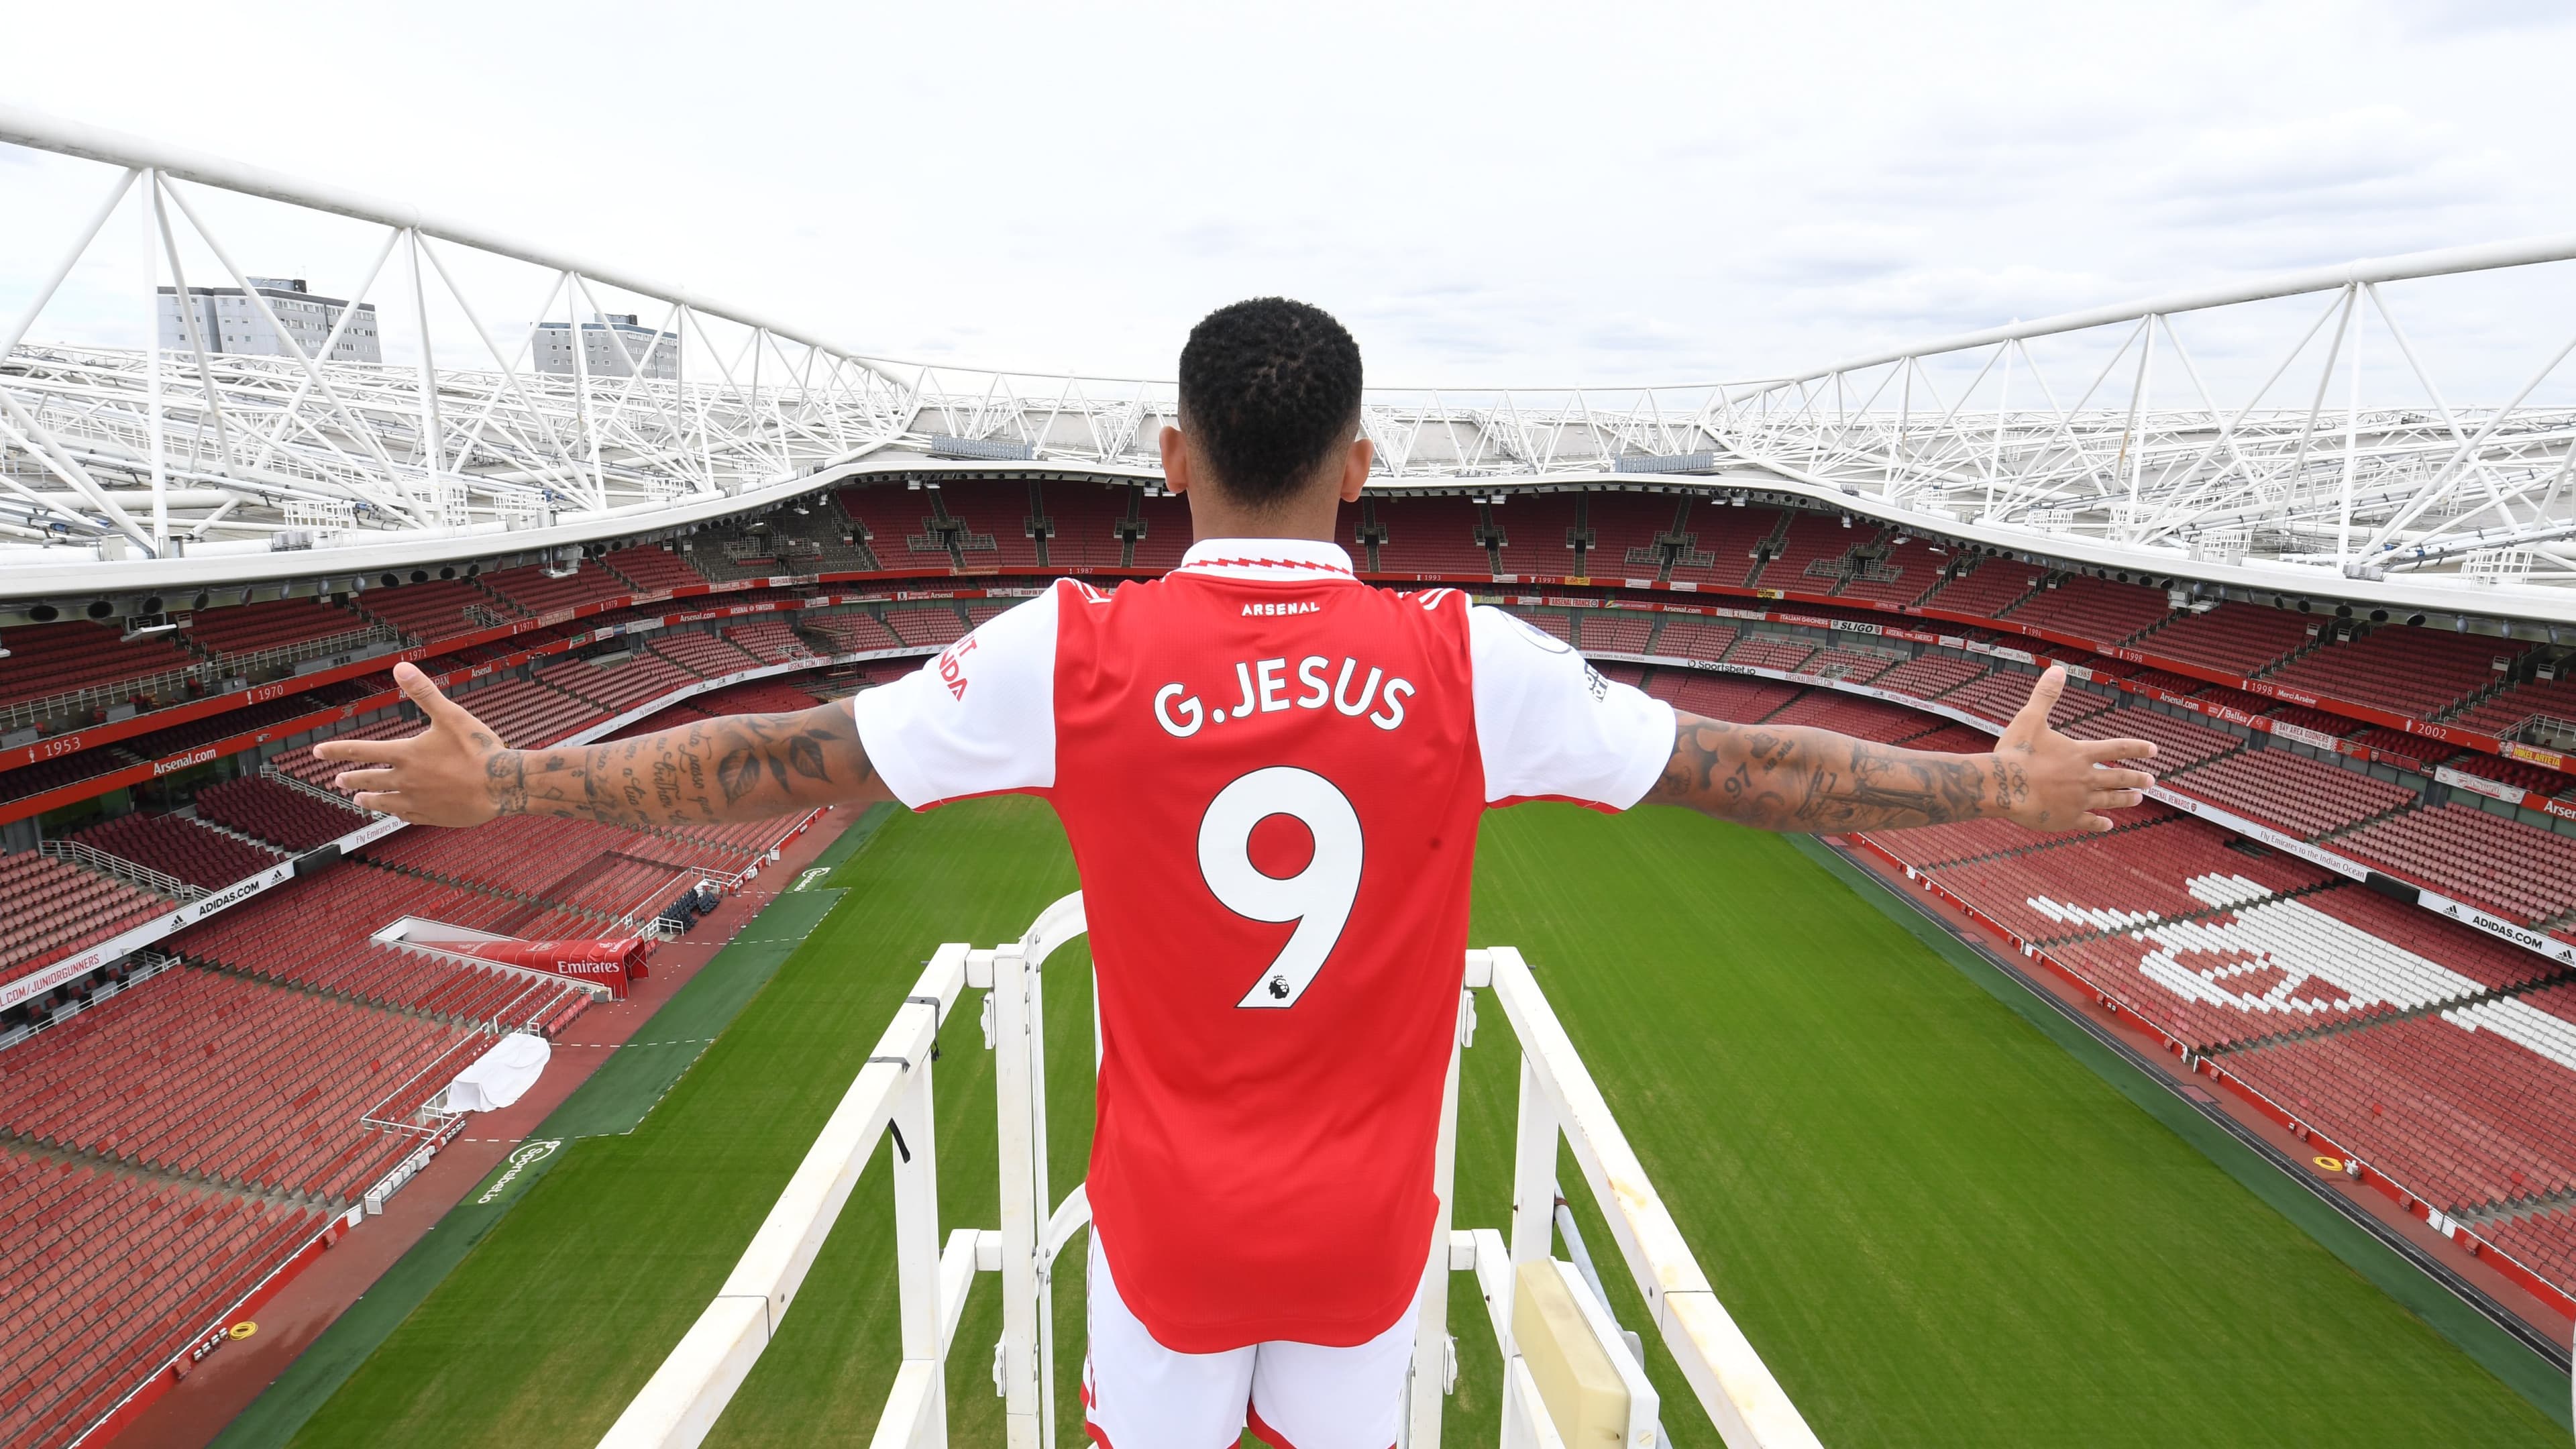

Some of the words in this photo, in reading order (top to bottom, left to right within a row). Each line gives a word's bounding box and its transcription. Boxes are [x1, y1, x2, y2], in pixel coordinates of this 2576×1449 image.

[930, 591, 954, 599] Arsenal
[606, 600, 618, 610] 1979
[731, 606, 748, 614] ARSENAL
[755, 603, 775, 611] SWEDEN
[1241, 601, 1321, 617] ARSENAL
[1662, 605, 1702, 614] Arsenal.com
[680, 612, 716, 623] Arsenal.com
[1780, 614, 1801, 622] ITALIAN
[519, 621, 533, 632] 1971
[1840, 622, 1874, 633] SLIGO
[2029, 628, 2042, 637] 1994
[409, 648, 427, 661] 1971
[2126, 651, 2143, 662] 1998
[471, 663, 492, 678] Arsenal
[1698, 660, 1756, 676] Sportsbet.io
[434, 676, 449, 687] PAN
[258, 684, 284, 700] 1970
[2251, 682, 2273, 696] 1998
[2277, 688, 2294, 700] Merci
[1153, 655, 1416, 739] G.JESUS
[2159, 691, 2199, 711] Arsenal.com
[2290, 727, 2303, 736] AREA
[2304, 730, 2330, 744] GOONERS
[2417, 723, 2447, 739] 2002
[44, 737, 81, 757] 1953
[153, 747, 217, 775] Arsenal.com
[2534, 753, 2561, 767] ARTETA
[2147, 786, 2167, 801] ARSENAL
[2167, 794, 2190, 810] REWARDS
[356, 834, 366, 845] Fly
[366, 824, 391, 839] Emirates
[2260, 830, 2270, 842] Fly
[2271, 835, 2298, 851] Emirates
[2299, 847, 2306, 855] to
[2307, 849, 2318, 860] the
[2320, 853, 2341, 869] Indian
[2342, 863, 2365, 879] Ocean
[1196, 765, 1364, 1009] 9
[199, 880, 260, 916] ADIDAS.COM
[2472, 915, 2543, 950] ADIDAS.COM
[557, 960, 620, 974] Emirates
